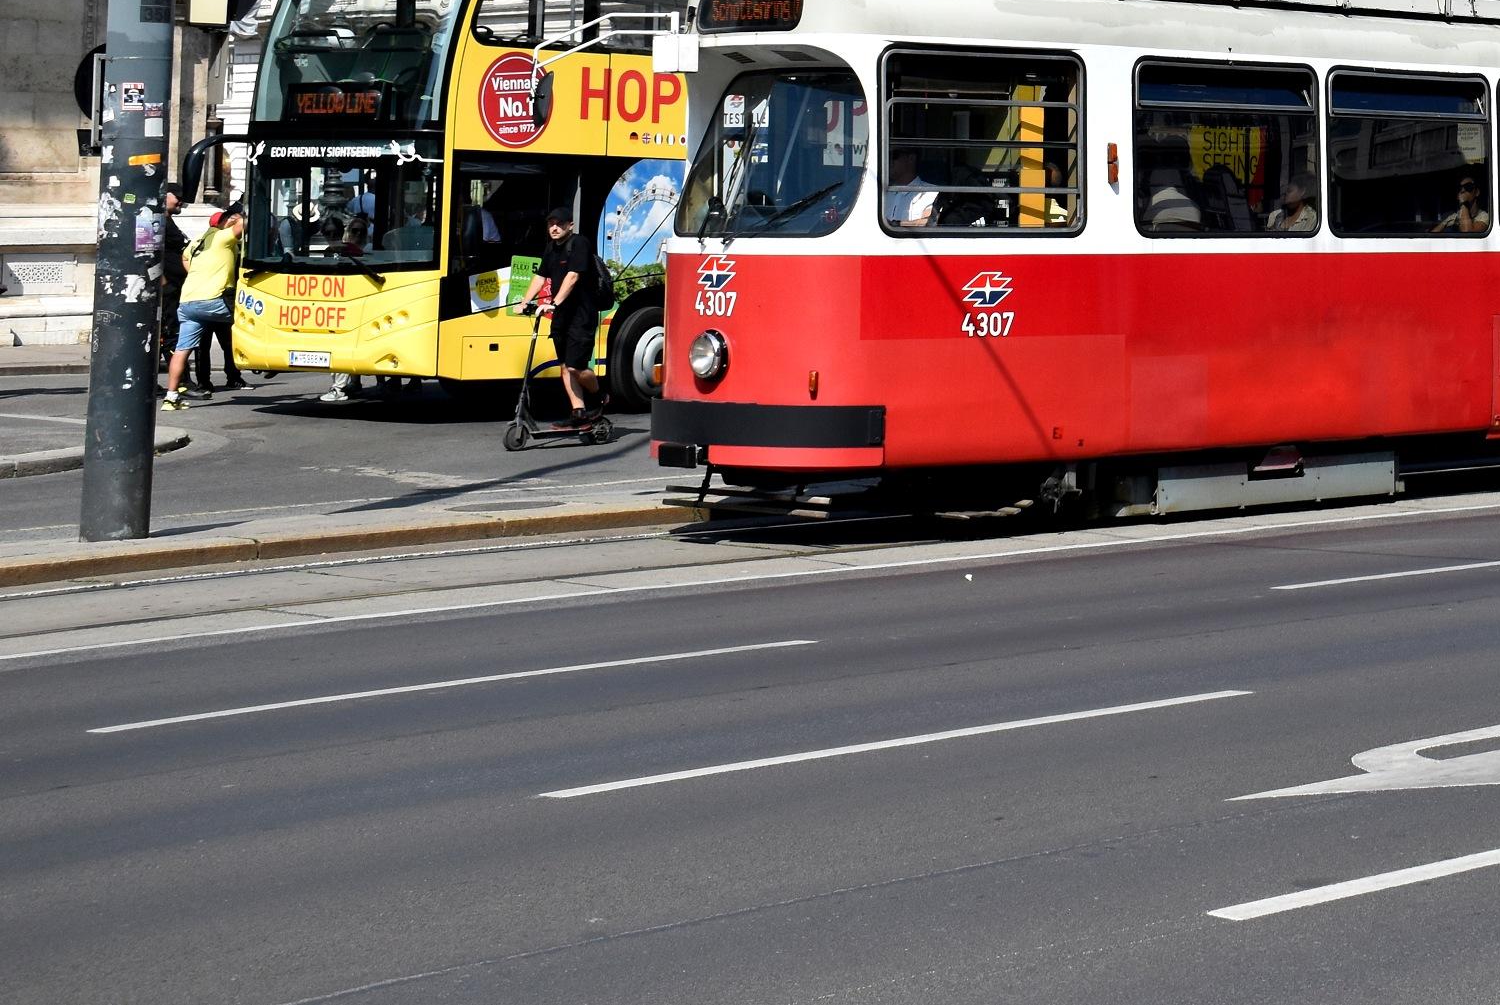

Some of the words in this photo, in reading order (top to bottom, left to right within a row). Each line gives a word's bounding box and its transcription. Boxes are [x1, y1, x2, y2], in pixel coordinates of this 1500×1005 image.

[297, 92, 346, 114] YELLOW
[347, 92, 376, 114] LINE
[580, 66, 682, 124] HOP
[499, 97, 535, 118] No.1
[498, 124, 518, 135] since
[519, 123, 536, 133] 1972
[270, 146, 287, 158] ECO
[287, 146, 326, 158] FRIENDLY
[327, 146, 382, 158] SIGHTSEEING
[1202, 130, 1246, 152] SIGHT
[286, 275, 319, 297] HOP
[322, 276, 346, 298] ON
[694, 291, 737, 317] 4307
[279, 305, 312, 327] HOP
[315, 306, 347, 328] OFF
[960, 311, 1015, 337] 4307
